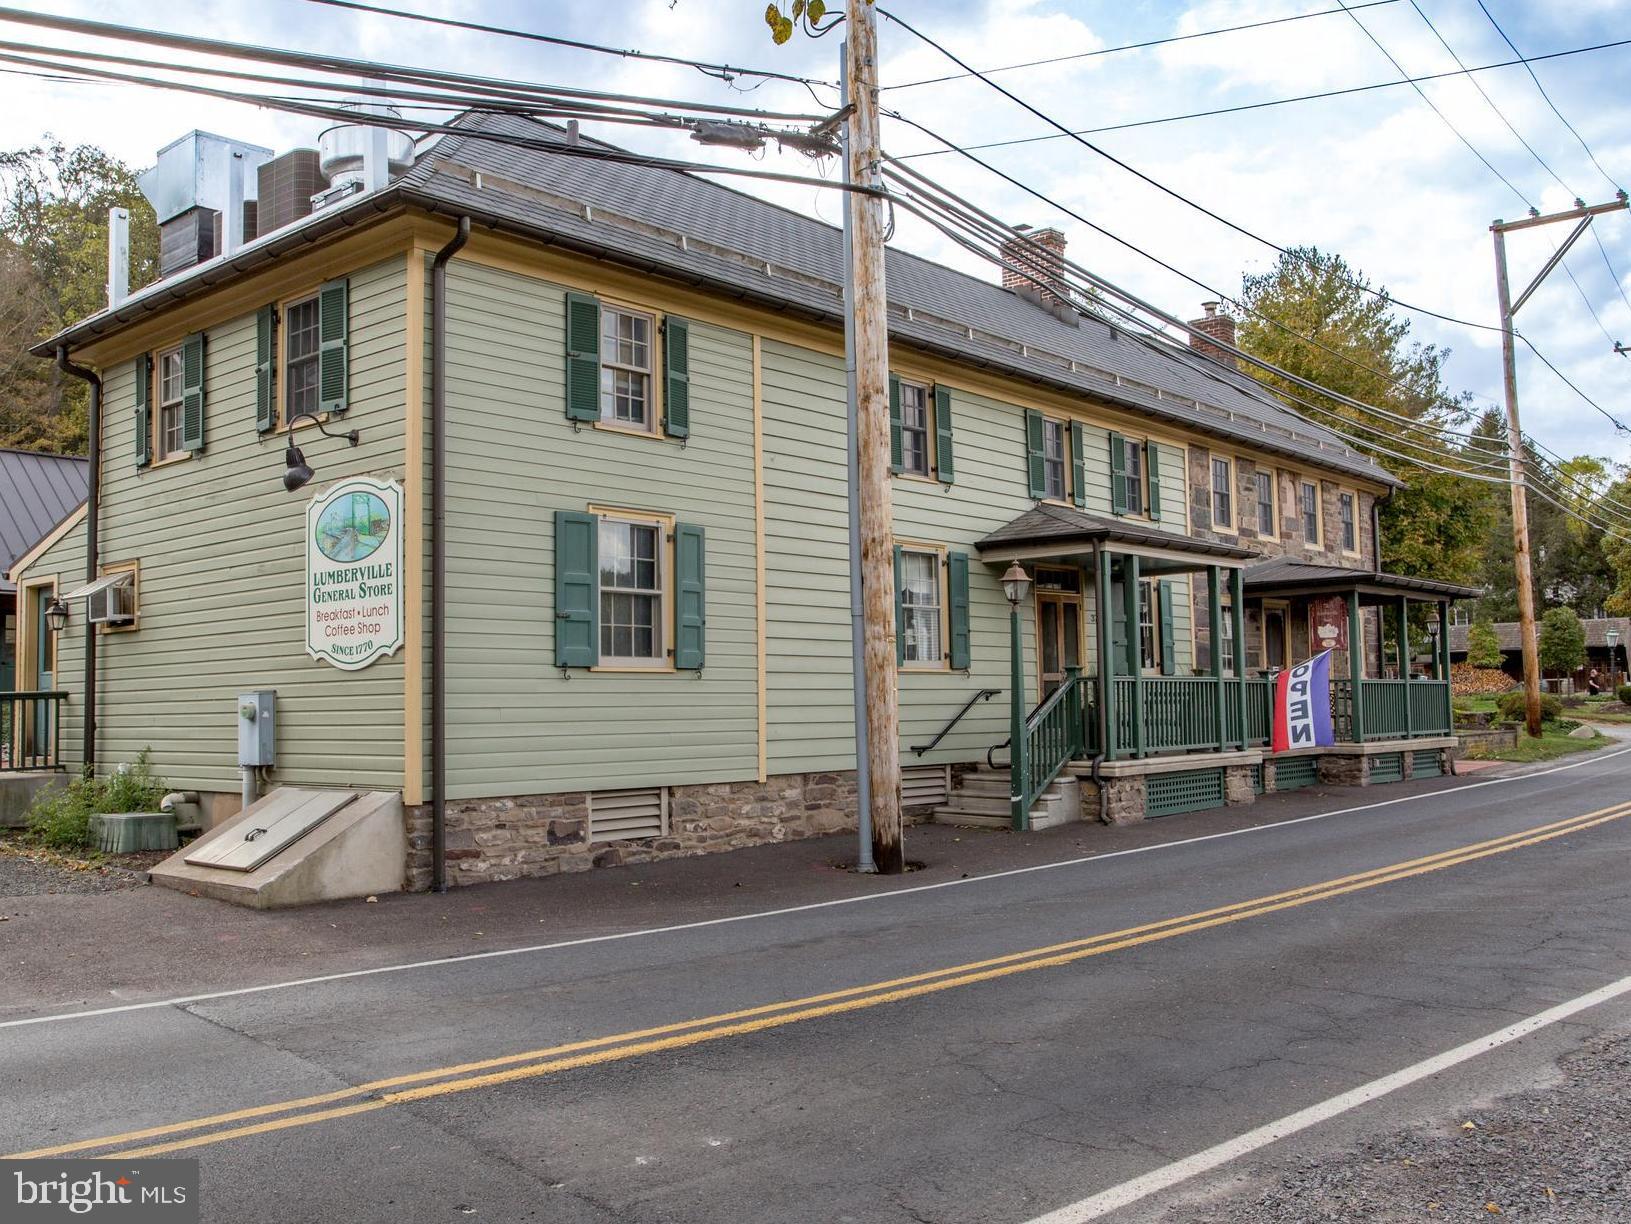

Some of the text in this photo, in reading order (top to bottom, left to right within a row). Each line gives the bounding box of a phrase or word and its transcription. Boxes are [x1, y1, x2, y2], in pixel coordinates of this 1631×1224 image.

[314, 563, 392, 586] LUMBERVILLE
[313, 582, 393, 603] GENERAL STORE
[316, 604, 389, 622] Breakfast Lunch
[324, 622, 381, 637] Coffee Shop
[331, 640, 373, 656] SINCE 1770
